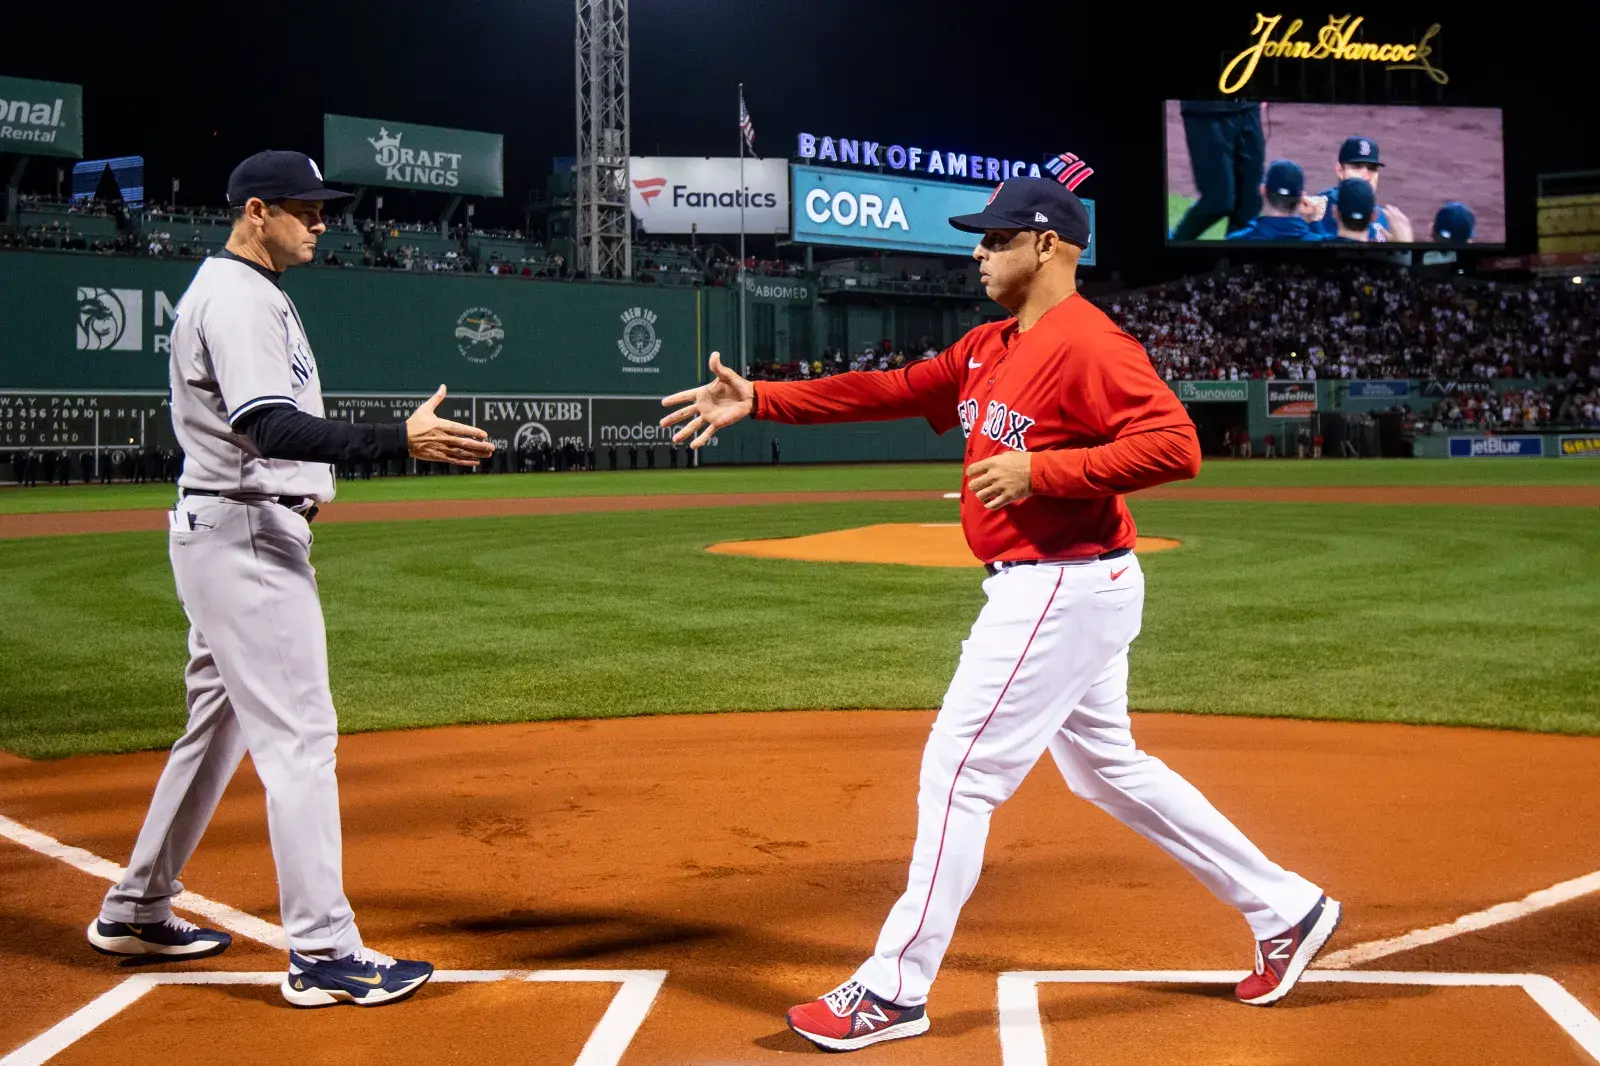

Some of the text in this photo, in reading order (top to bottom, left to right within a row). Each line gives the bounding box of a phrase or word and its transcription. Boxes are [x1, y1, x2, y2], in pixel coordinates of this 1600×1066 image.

[1218, 13, 1449, 94] John Hancock
[1, 126, 56, 143] Rental
[375, 145, 462, 169] DRAFT
[798, 132, 1042, 181] BANK OF AMERICA
[386, 163, 459, 187] KINGS
[673, 185, 777, 208] Fanatics
[805, 188, 910, 231] CORA
[755, 285, 808, 299] ABIOMED
[52, 398, 98, 406] PARK
[1196, 388, 1244, 399] sunovion
[1269, 390, 1315, 401] Safelite
[338, 400, 386, 408] NATIONAL
[484, 401, 583, 420] F.W. WEBB
[601, 421, 685, 440] moderna
[981, 400, 1035, 452] SOX
[1471, 437, 1521, 456] jetBlue
